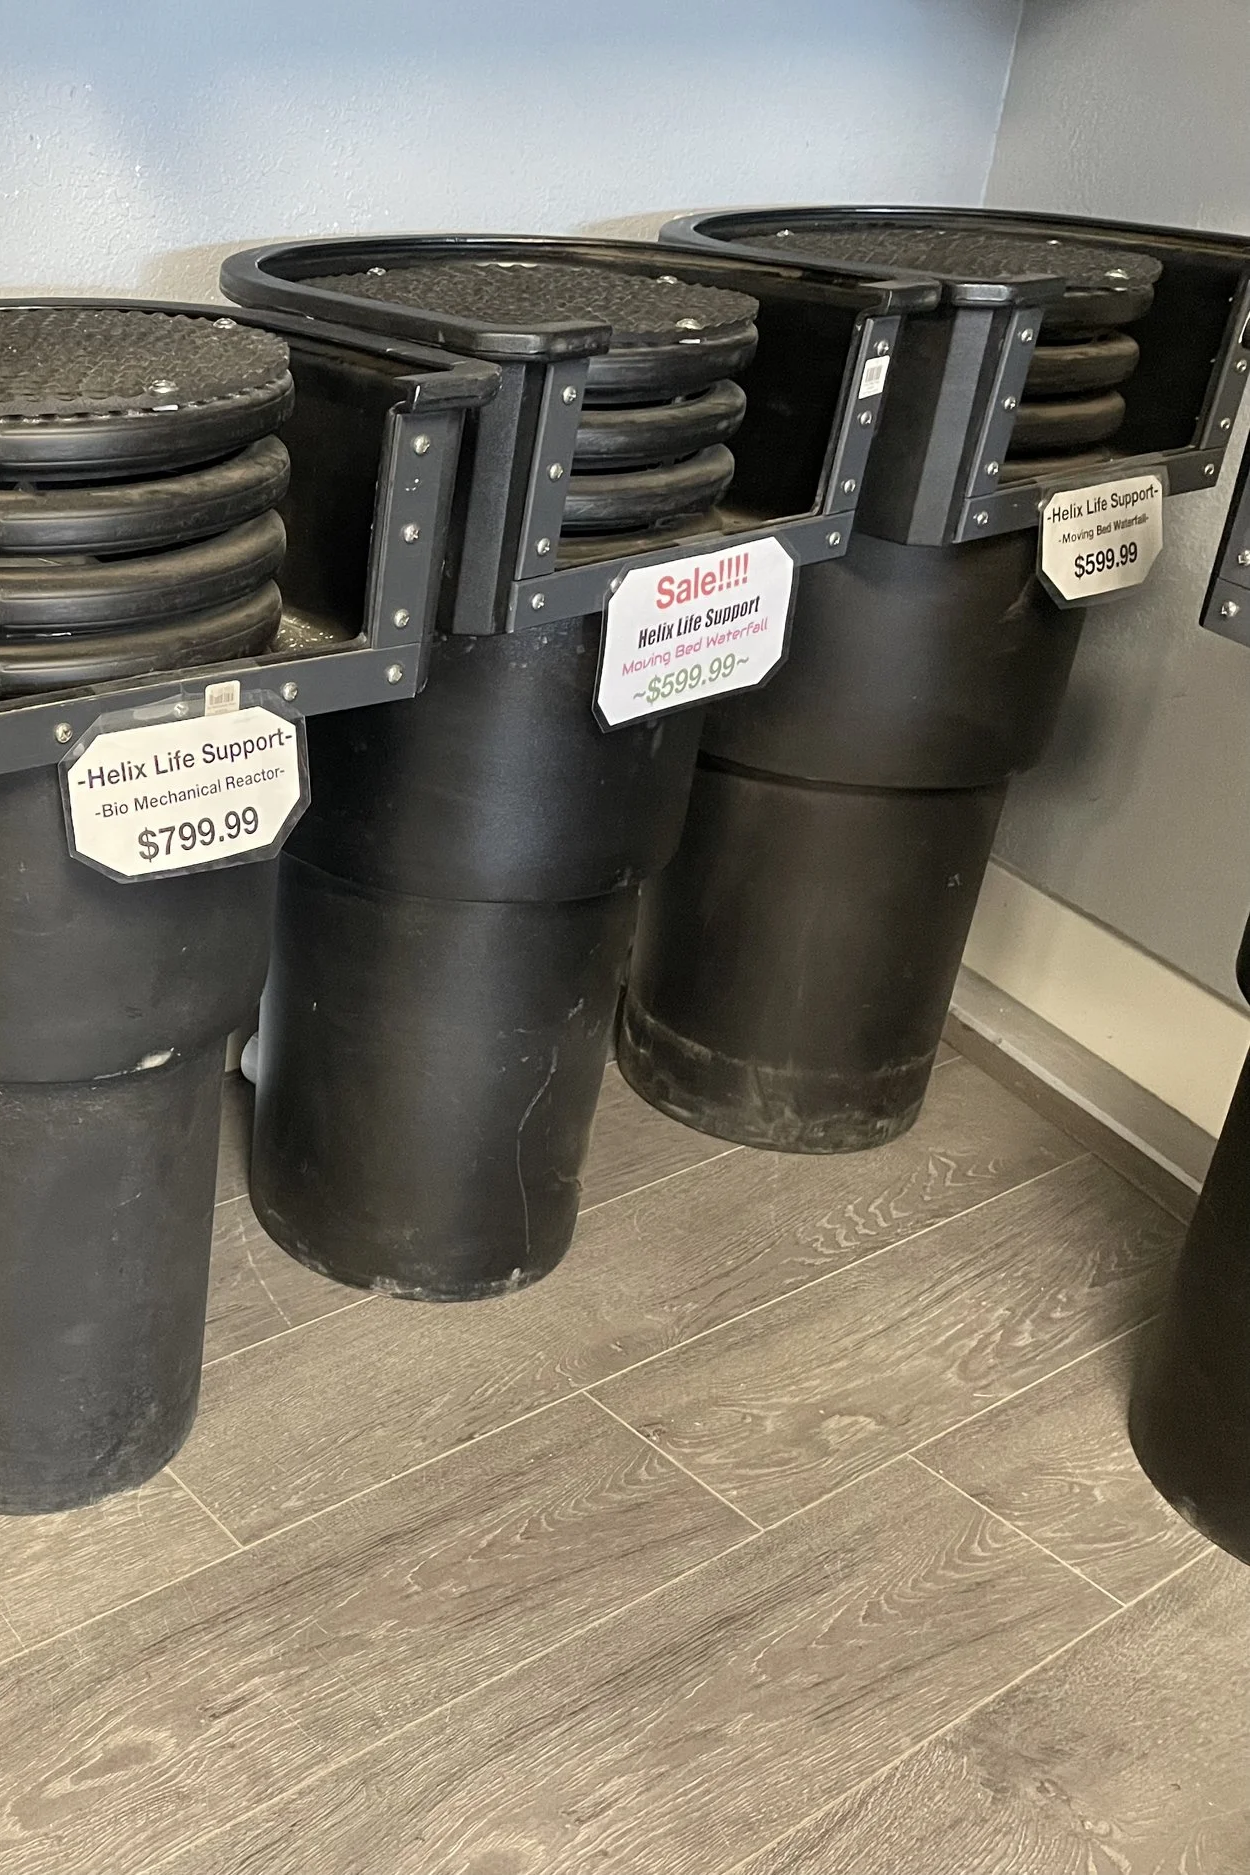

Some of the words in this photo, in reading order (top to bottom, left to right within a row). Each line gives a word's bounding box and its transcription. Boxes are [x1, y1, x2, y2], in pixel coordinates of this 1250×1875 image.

[1047, 503, 1083, 523] -Helix
[1086, 497, 1108, 515] Life
[1110, 484, 1159, 509] Support-
[1059, 528, 1094, 544] -Moving
[1096, 521, 1112, 536] Bed
[656, 552, 749, 610] Sale!!!!
[1074, 541, 1138, 580] $599.99
[638, 621, 675, 649] Helix
[676, 614, 702, 637] Life
[705, 595, 760, 628] Support
[622, 651, 671, 677] Moving
[675, 637, 703, 658] Bed
[77, 760, 148, 789] -Helix
[154, 750, 195, 775] Life
[201, 728, 293, 764] Support-
[95, 801, 129, 819] -Bio
[134, 779, 222, 811] Mechanical
[226, 766, 285, 790] Reactor-
[138, 806, 259, 863] $799.99
